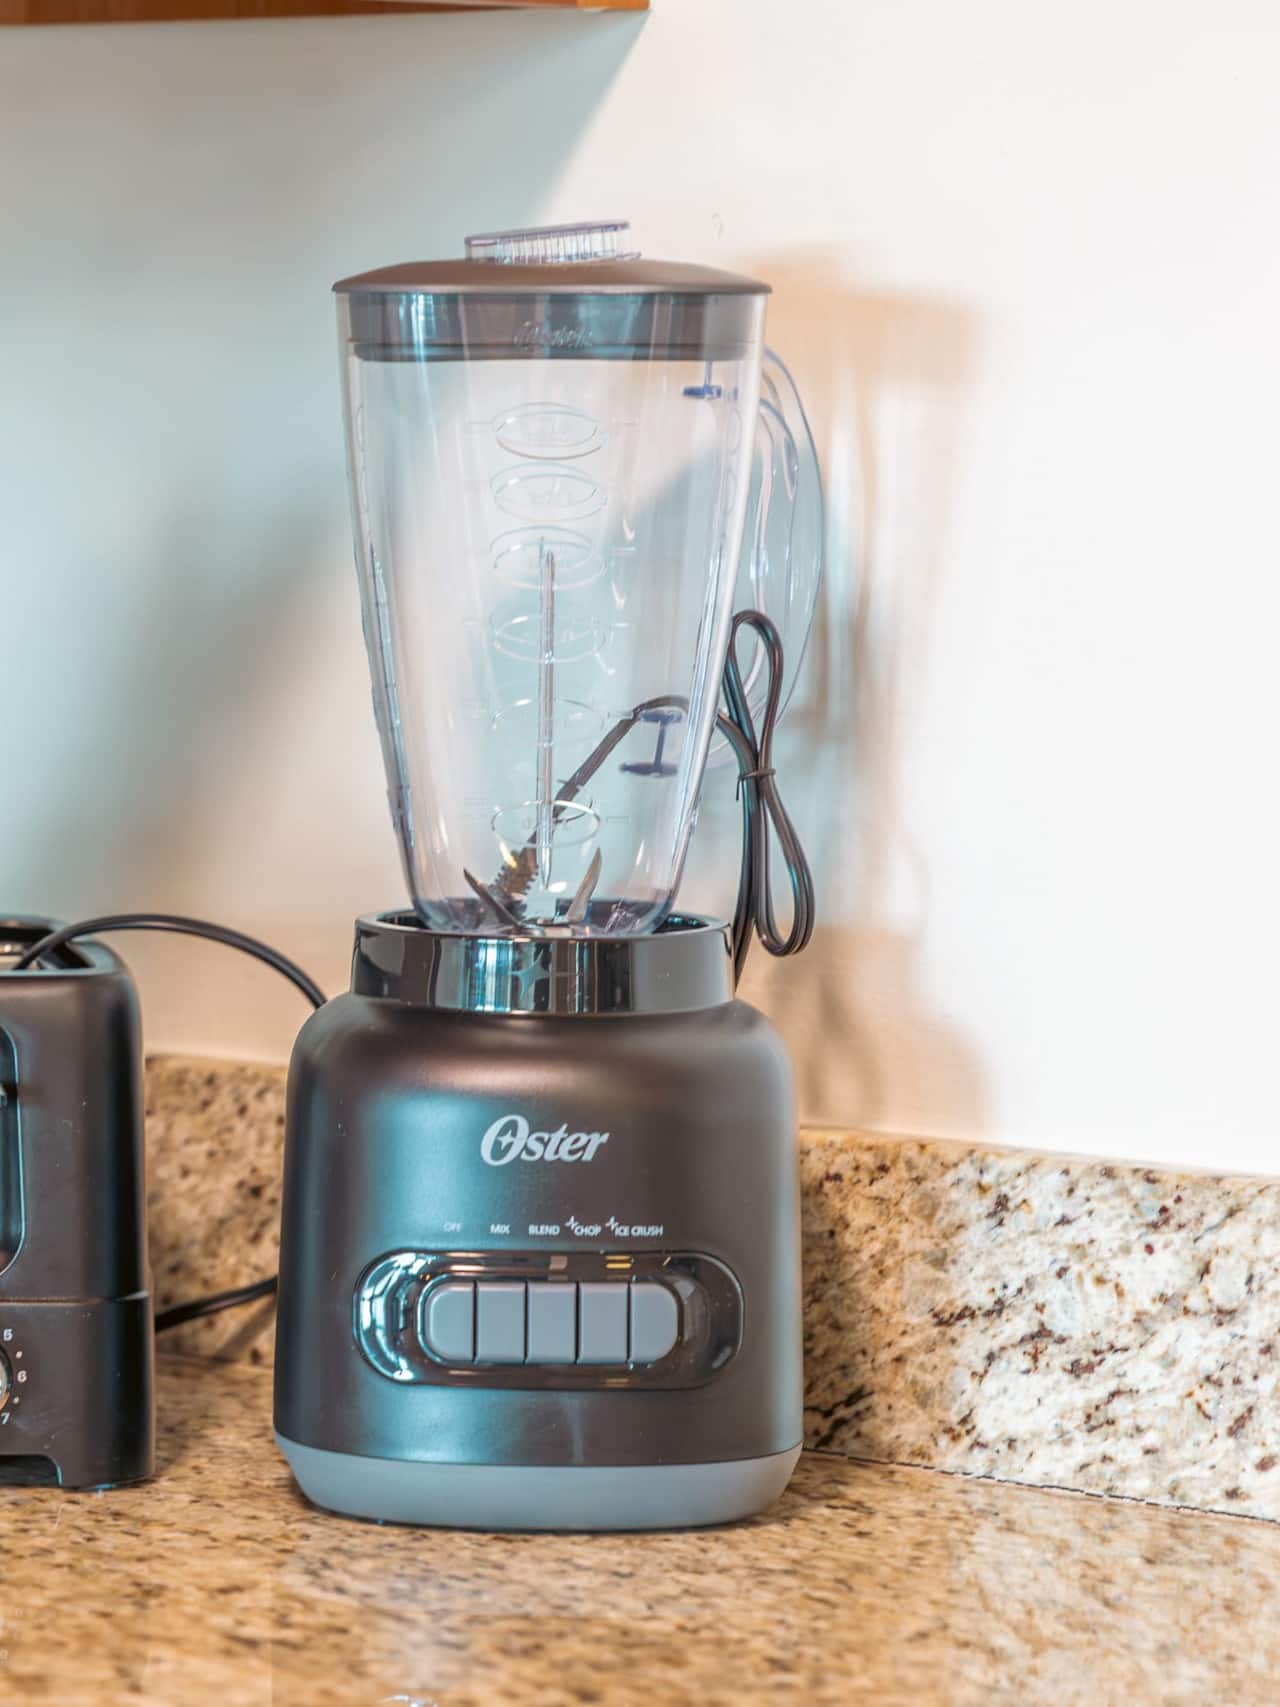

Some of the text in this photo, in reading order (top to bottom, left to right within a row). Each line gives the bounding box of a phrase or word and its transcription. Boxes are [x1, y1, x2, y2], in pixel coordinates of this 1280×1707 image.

[480, 1114, 610, 1167] Oster
[489, 1223, 511, 1235] MIX
[528, 1223, 561, 1236] BLEND
[573, 1224, 602, 1237] CHOP
[614, 1225, 664, 1237] ICE CRUSH
[3, 1328, 13, 1342] 5
[17, 1370, 27, 1383] 6
[0, 1412, 10, 1425] 7
